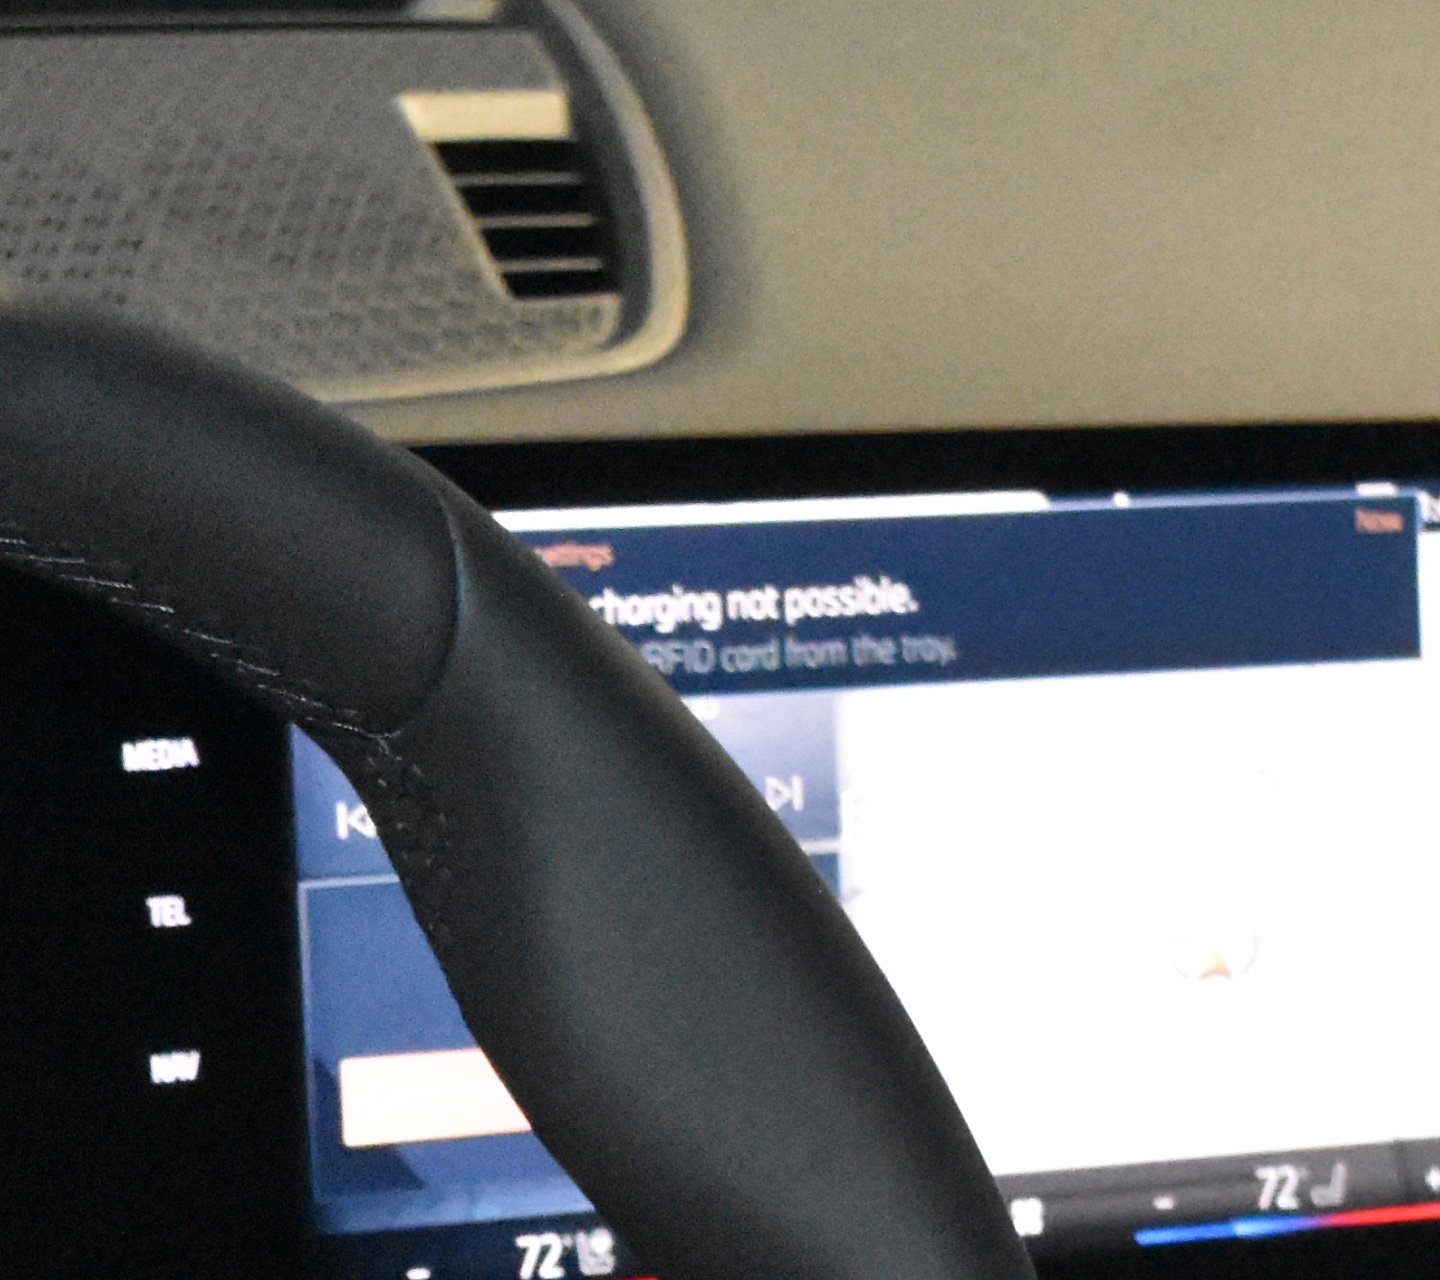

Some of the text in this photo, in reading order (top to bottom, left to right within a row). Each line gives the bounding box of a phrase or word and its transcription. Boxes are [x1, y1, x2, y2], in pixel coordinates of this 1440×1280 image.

[726, 585, 780, 621] not
[784, 575, 920, 626] possible.
[720, 637, 780, 673] card
[785, 634, 849, 669] from
[852, 634, 896, 666] the
